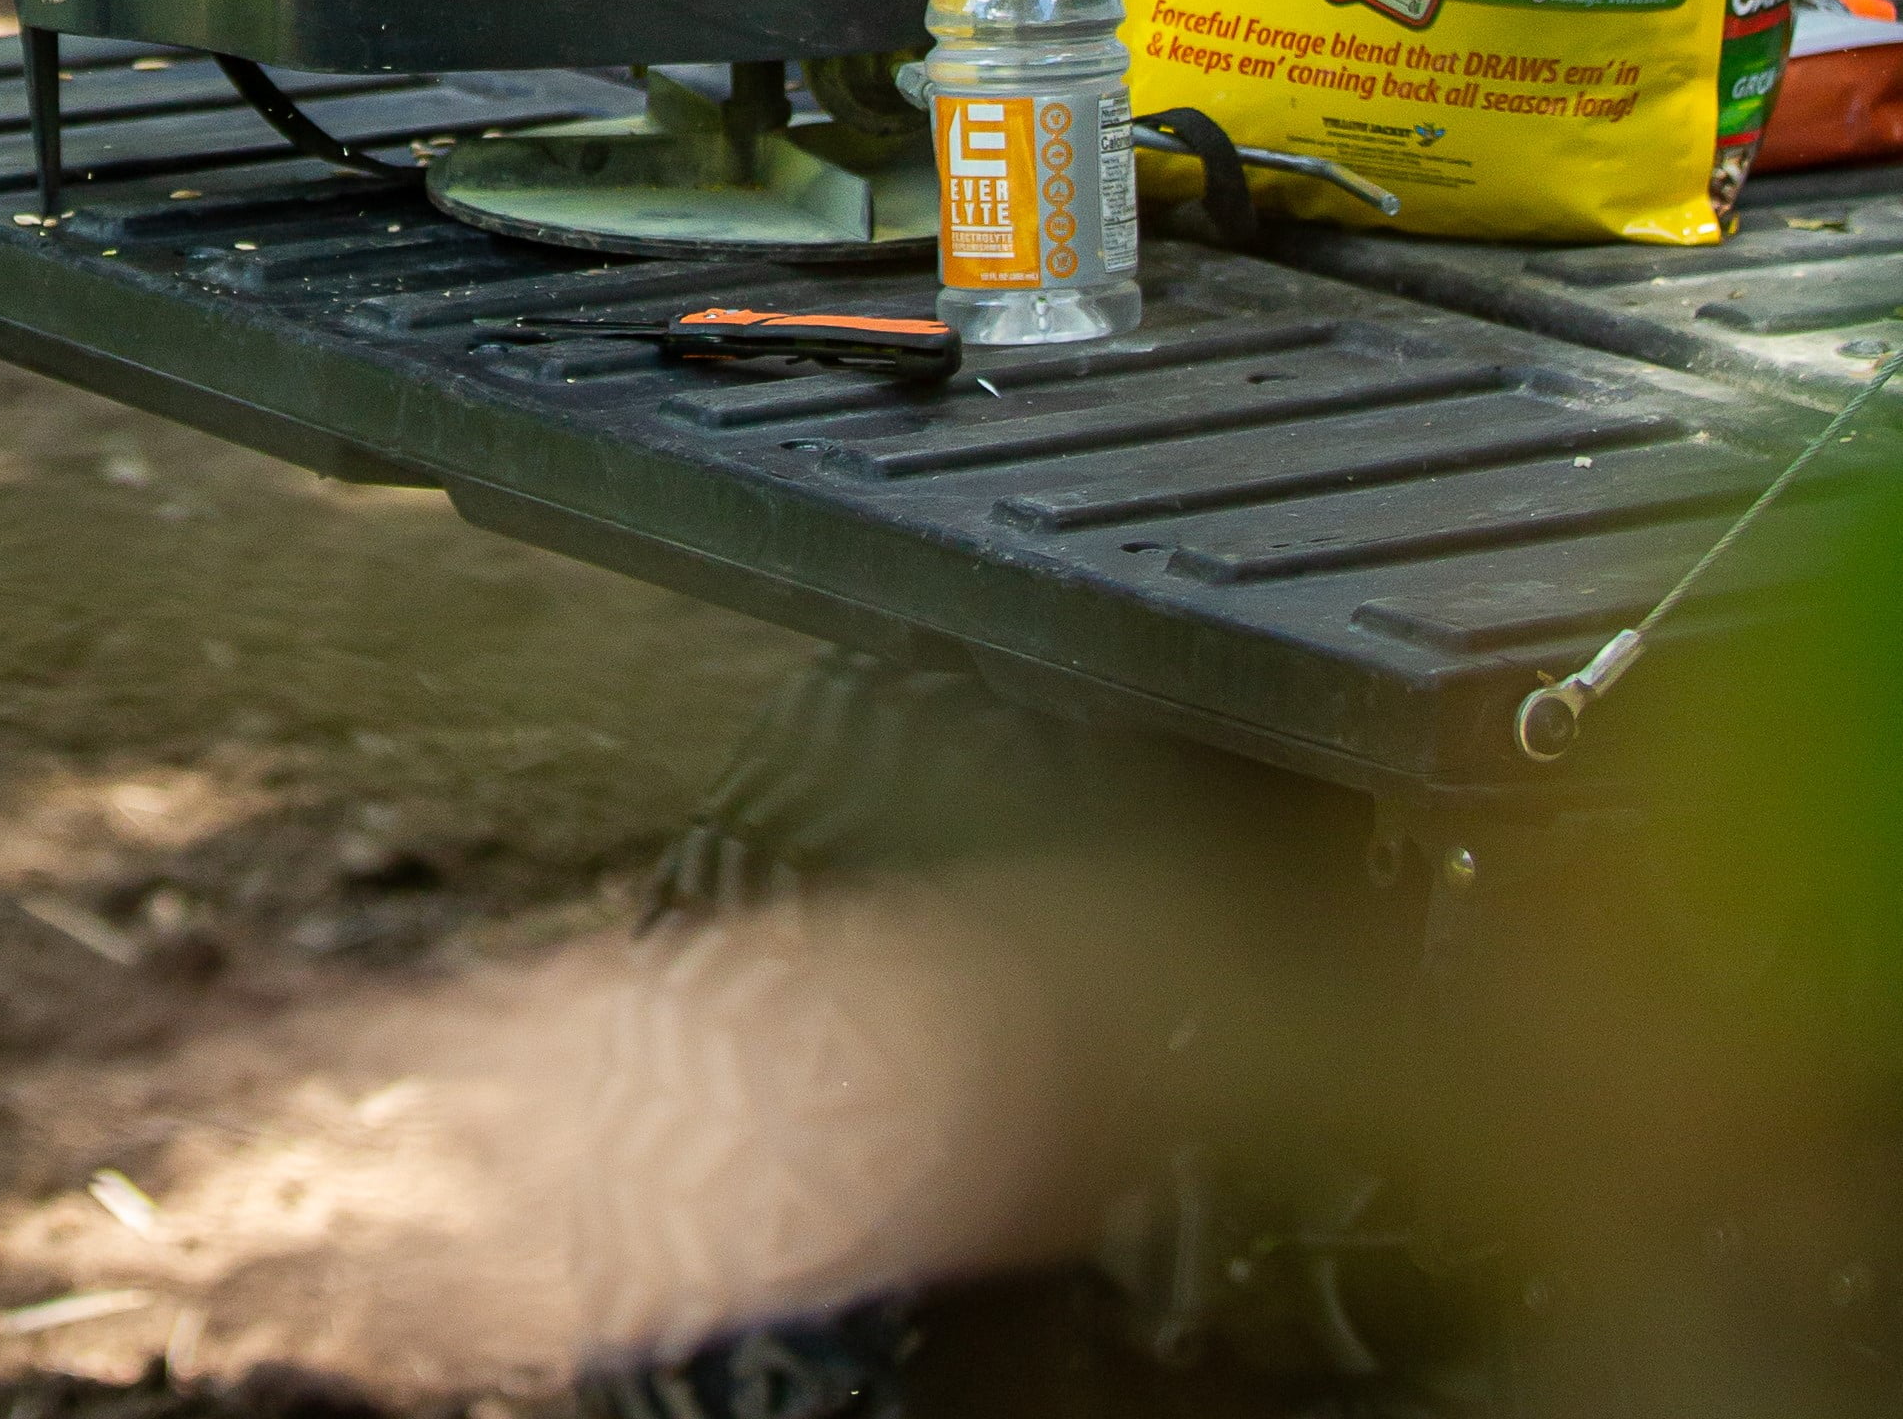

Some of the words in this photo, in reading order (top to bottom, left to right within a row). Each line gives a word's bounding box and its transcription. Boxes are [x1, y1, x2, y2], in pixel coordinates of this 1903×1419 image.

[1151, 0, 1241, 41] Forceful
[1243, 17, 1326, 59] Forage
[1329, 31, 1401, 67] blend
[1405, 44, 1458, 74] that
[1462, 51, 1561, 85] DRAWS
[1615, 59, 1641, 86] in
[1146, 31, 1164, 59] &
[1168, 36, 1234, 75] keeps
[1287, 65, 1377, 101] coming
[1380, 70, 1445, 104] back
[1445, 82, 1479, 109] all
[1482, 91, 1568, 117] season
[1572, 90, 1639, 123] long!
[950, 178, 1009, 202] EVER
[951, 203, 1011, 225] LYTE
